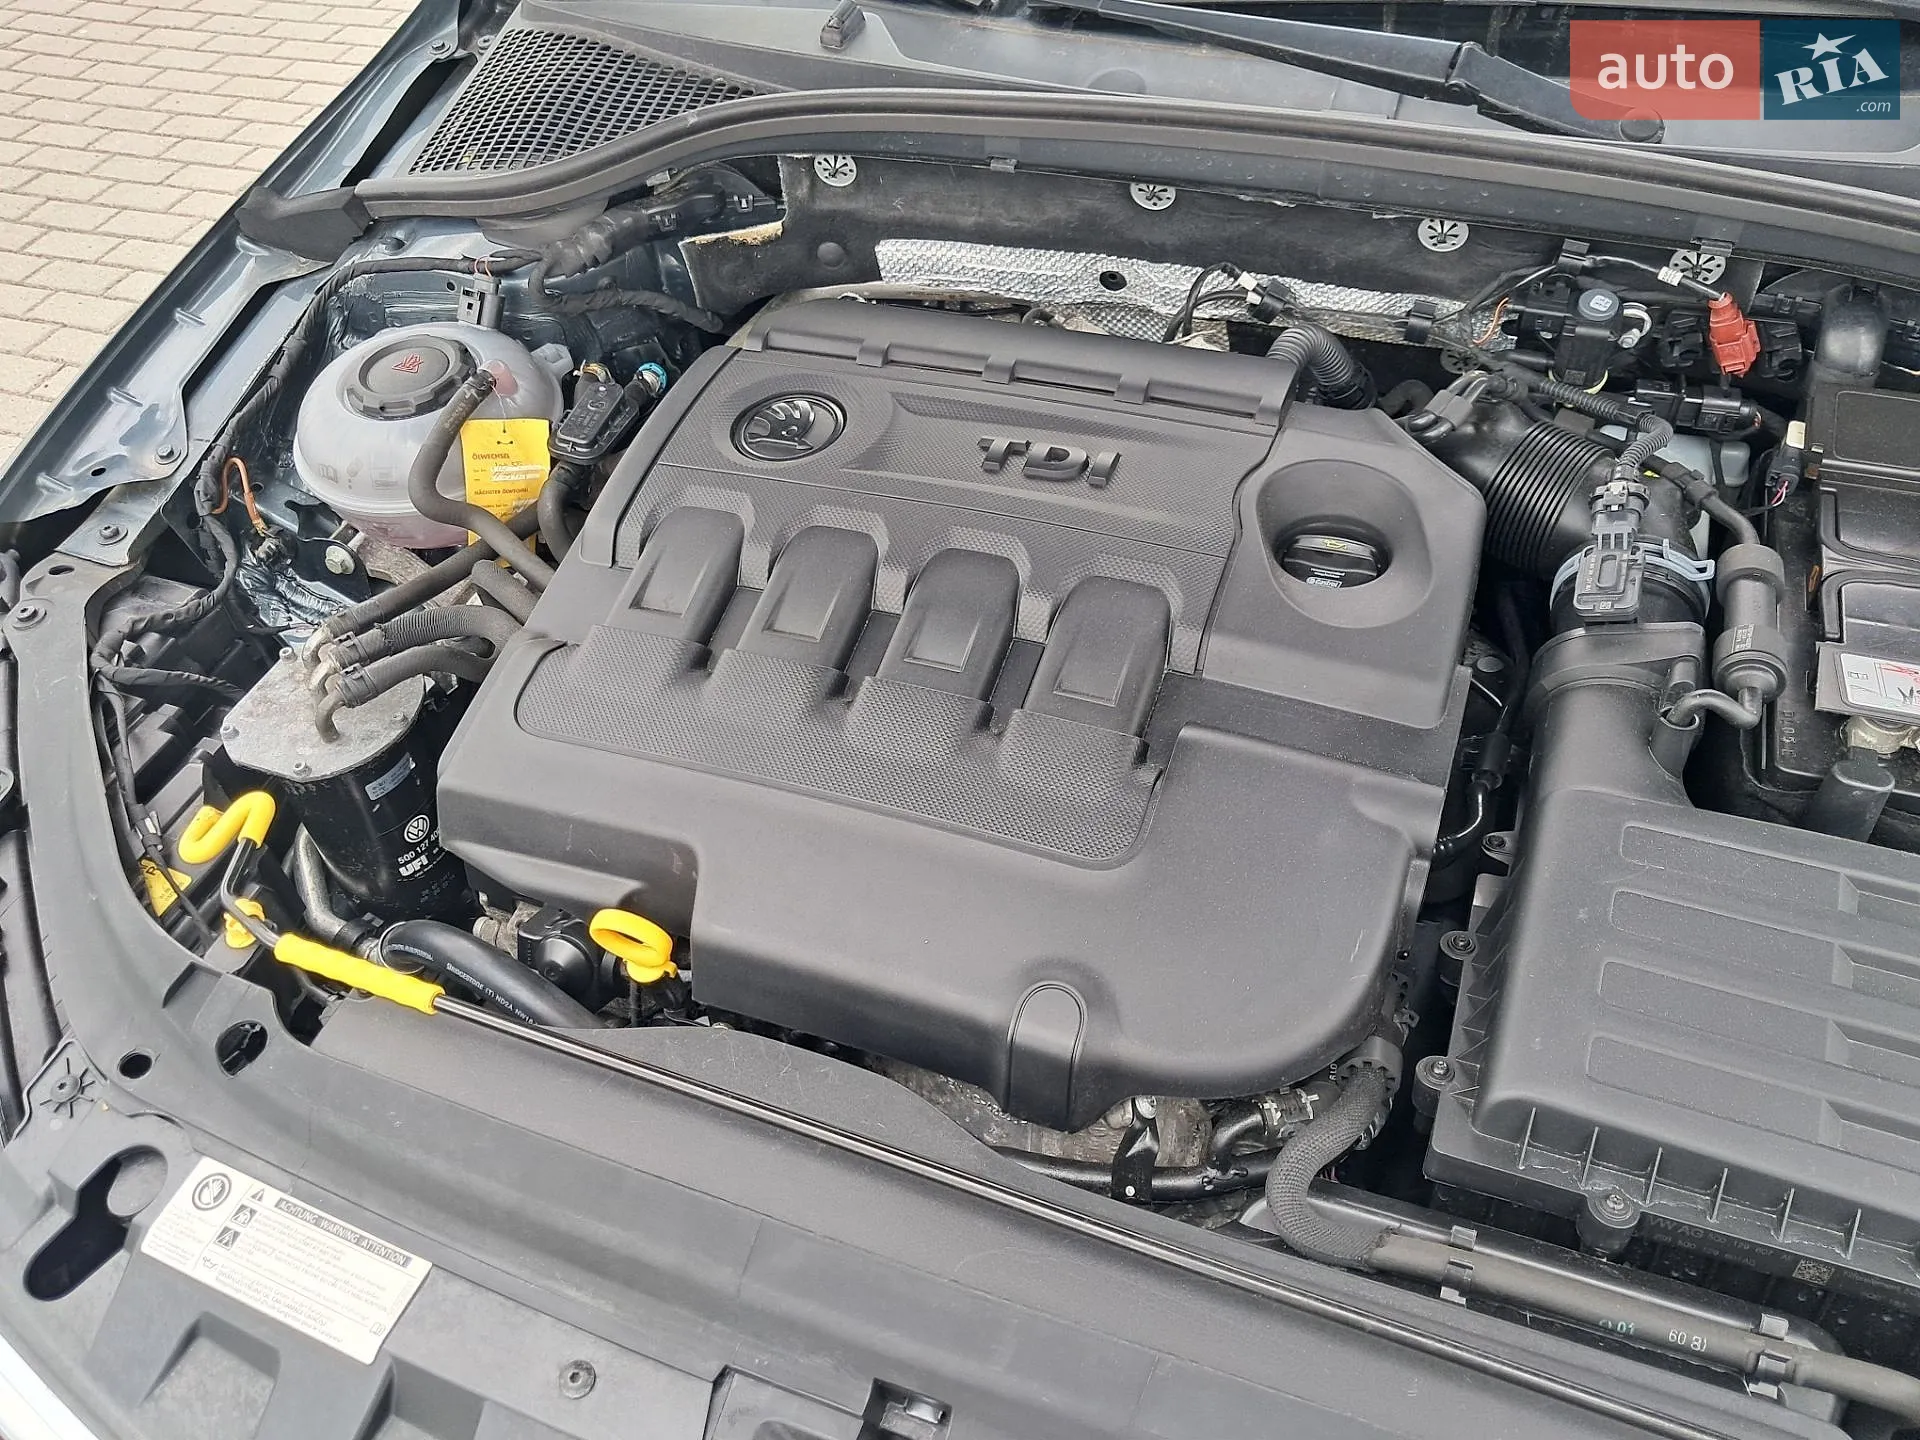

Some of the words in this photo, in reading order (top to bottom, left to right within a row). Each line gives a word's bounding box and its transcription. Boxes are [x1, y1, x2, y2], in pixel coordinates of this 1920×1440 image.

[471, 452, 510, 461] ÖLWECHSEL
[976, 436, 1122, 488] TDI
[415, 838, 429, 854] 127
[398, 854, 429, 877] UFI
[277, 1198, 318, 1224] ACHTUNG
[319, 1213, 361, 1244] WARNING
[361, 1233, 407, 1266] ATTENTION
